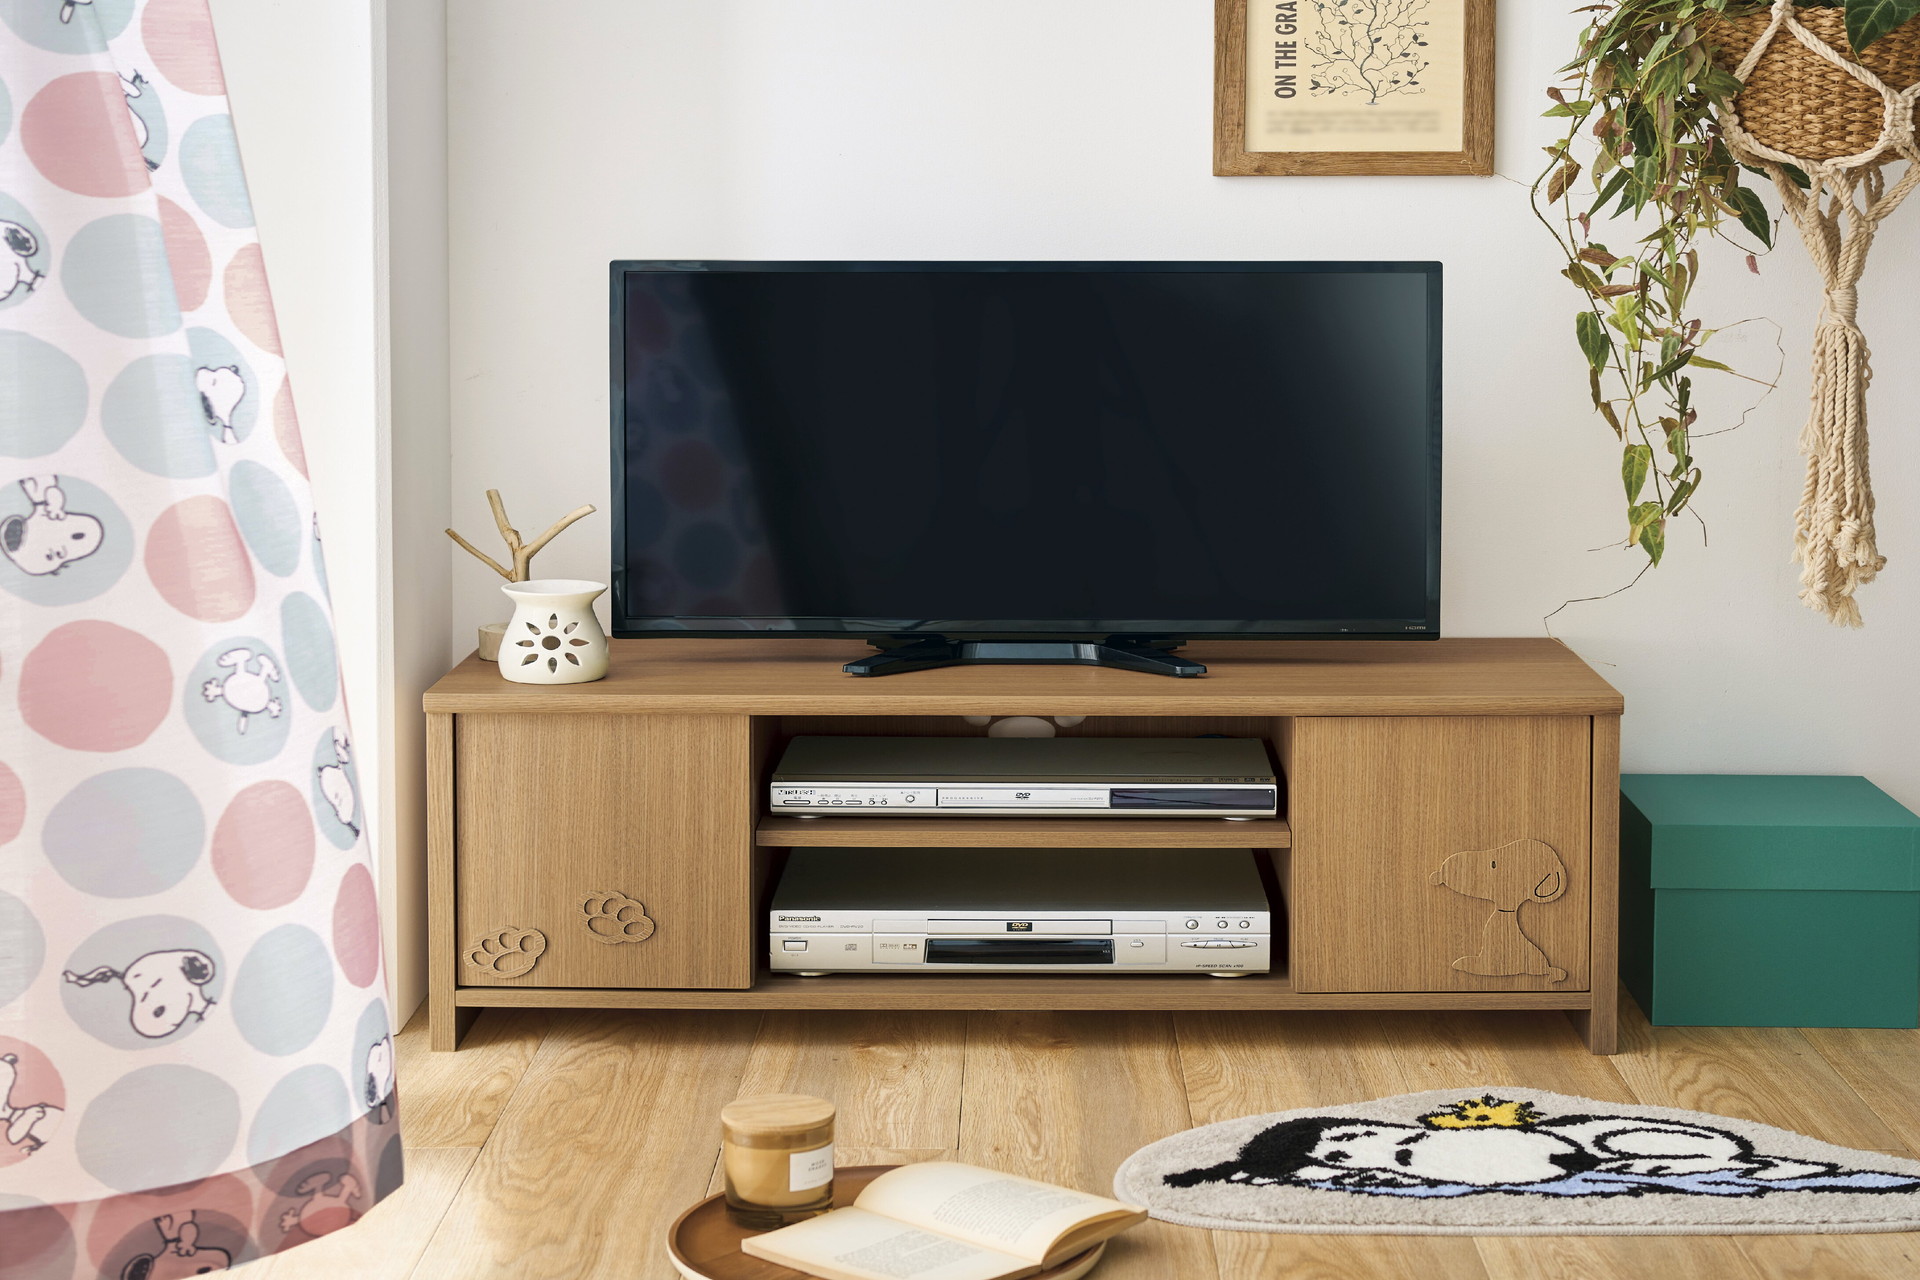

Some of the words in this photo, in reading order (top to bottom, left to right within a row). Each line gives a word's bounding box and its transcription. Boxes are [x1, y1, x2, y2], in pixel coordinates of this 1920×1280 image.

[1274, 0, 1297, 35] GRA
[1274, 41, 1297, 69] THE
[1274, 75, 1297, 99] ON
